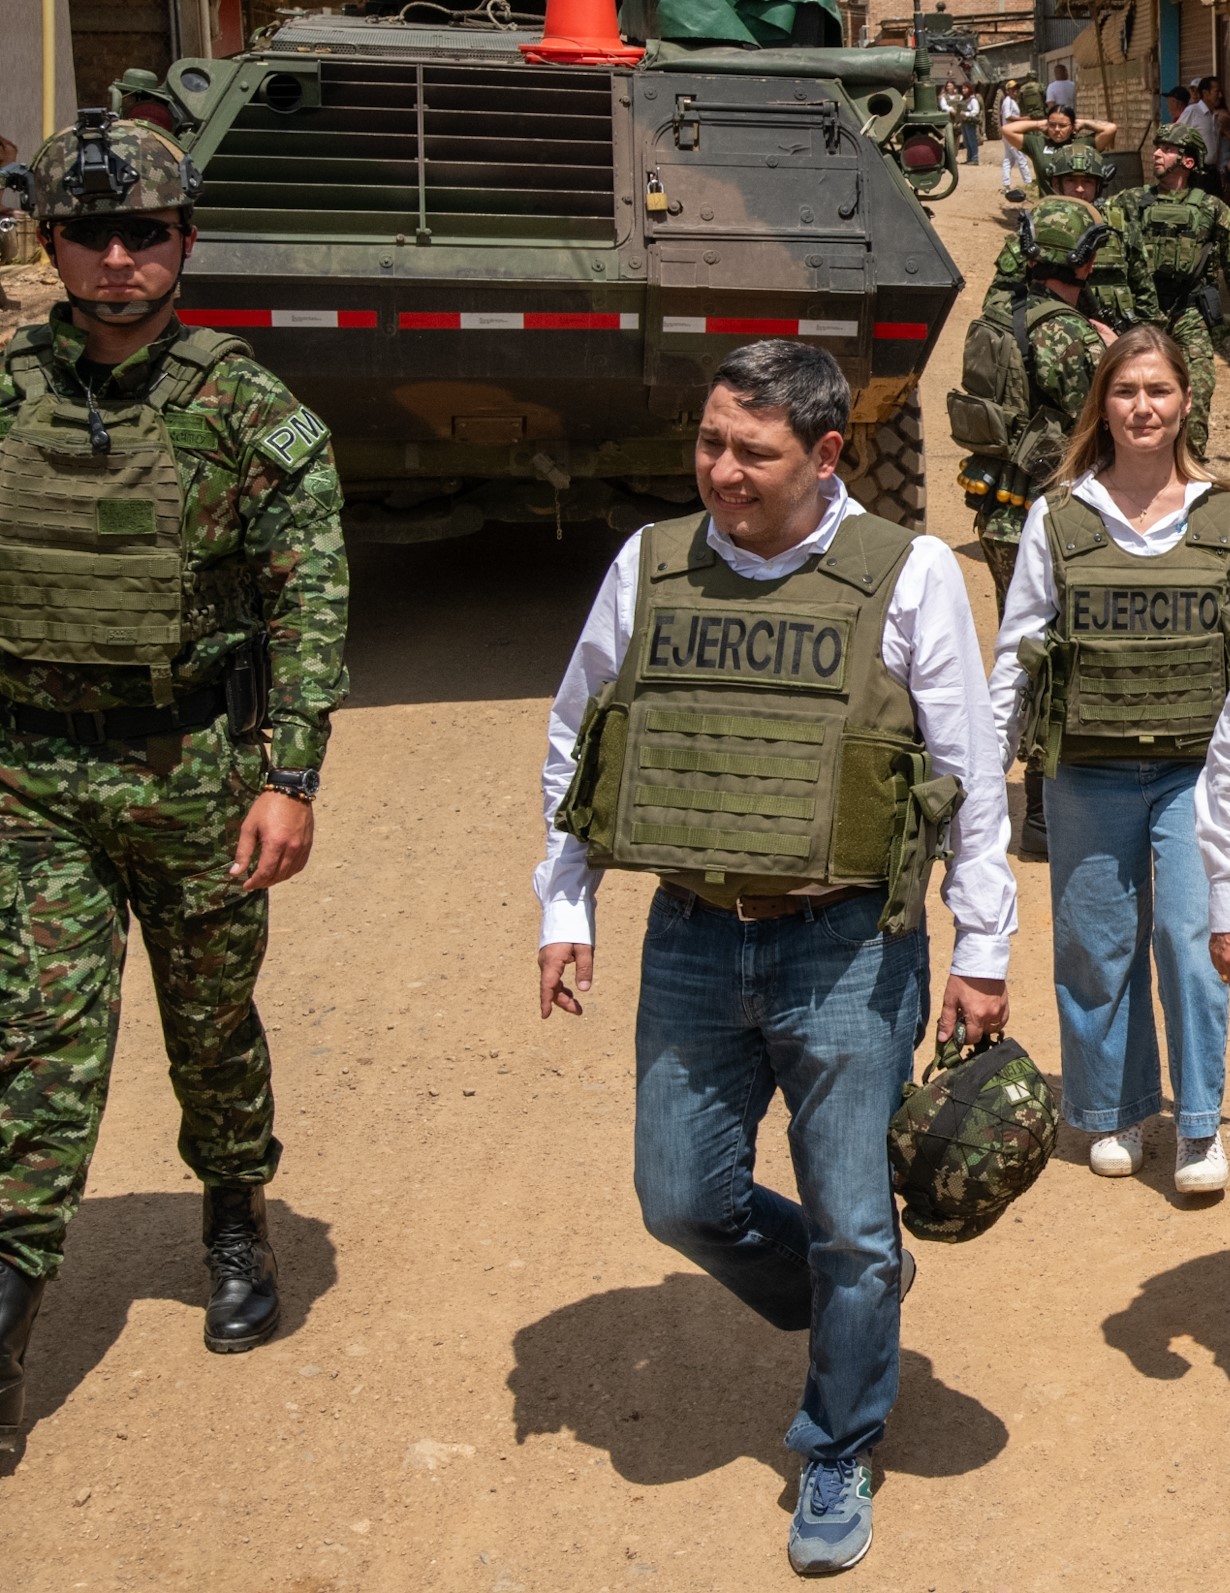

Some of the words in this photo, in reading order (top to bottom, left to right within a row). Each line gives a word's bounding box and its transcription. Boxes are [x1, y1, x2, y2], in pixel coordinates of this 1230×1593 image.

[264, 406, 326, 463] PM
[1073, 591, 1219, 632] EJERCITO
[648, 615, 843, 679] EJERCITO
